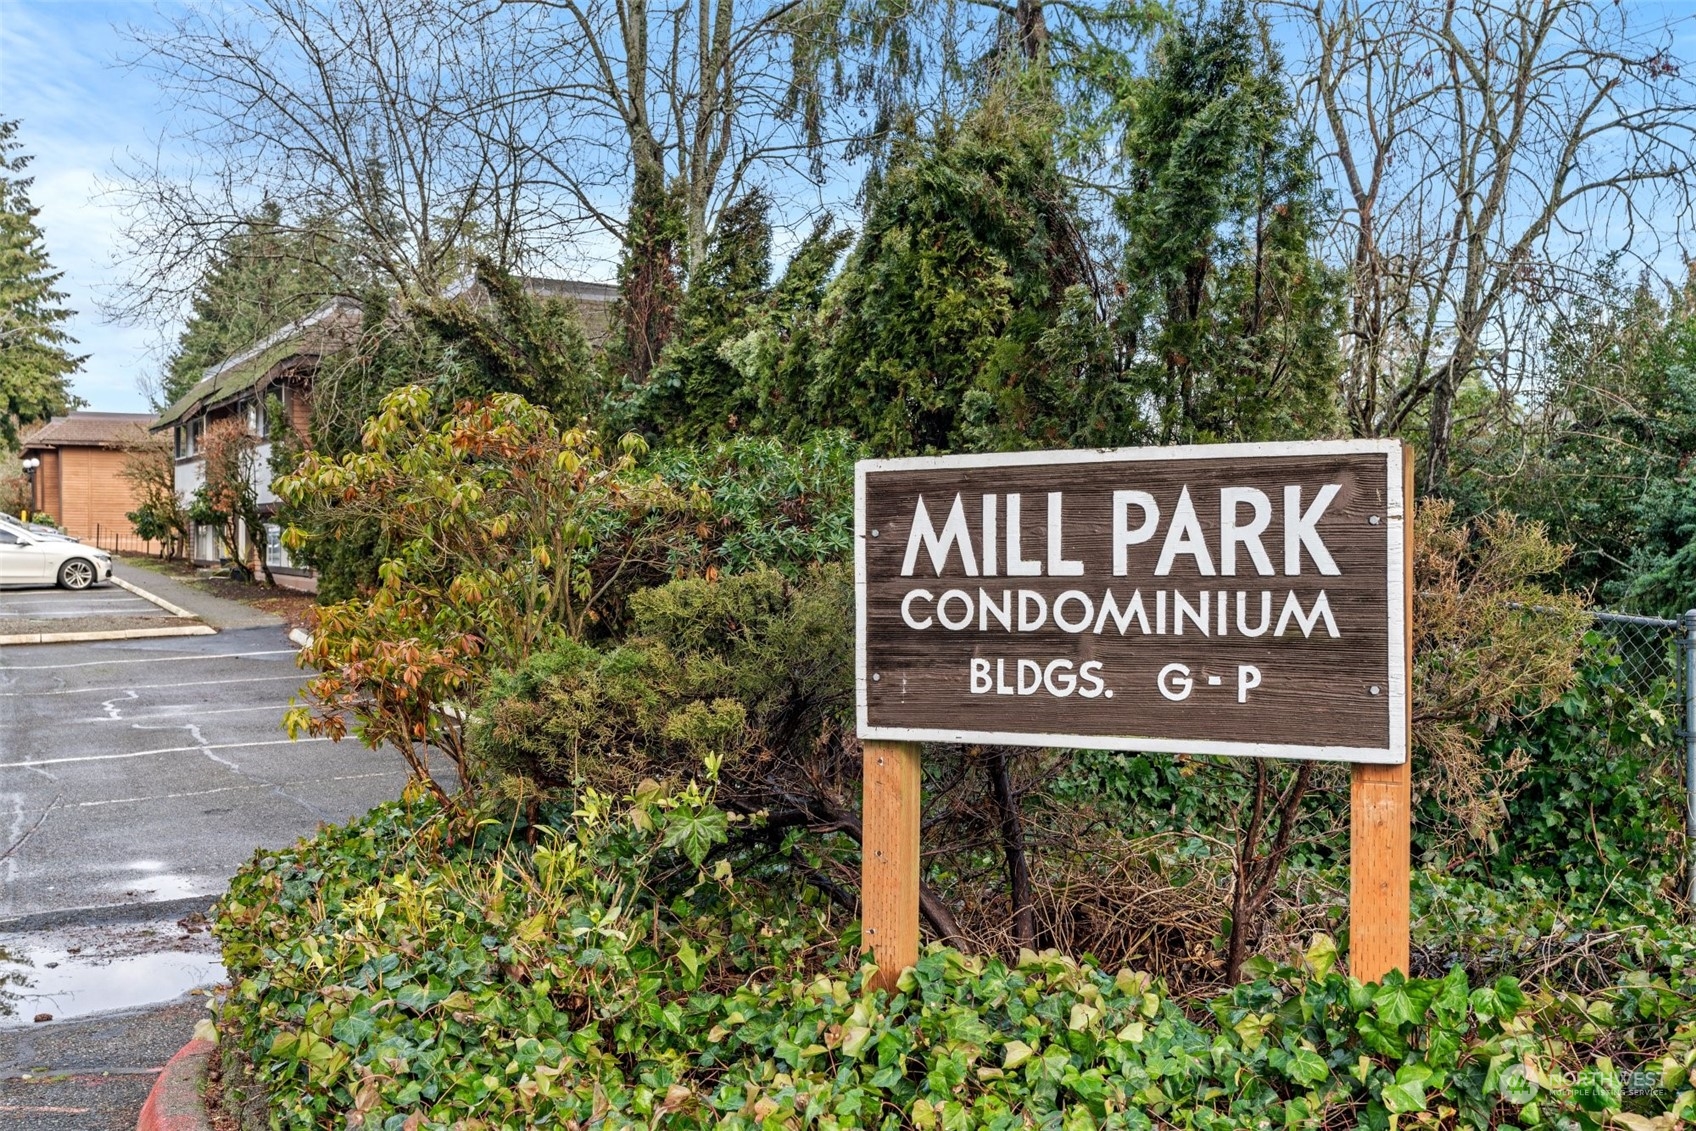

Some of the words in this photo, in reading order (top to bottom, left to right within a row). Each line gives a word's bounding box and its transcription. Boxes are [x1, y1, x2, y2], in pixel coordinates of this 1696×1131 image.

[901, 491, 1084, 577] MILL
[1112, 484, 1342, 577] PARK
[901, 586, 1341, 638] CONDOMINIUM
[970, 657, 1114, 699] BLDGS.
[1157, 662, 1193, 701] G
[1237, 665, 1262, 703] P
